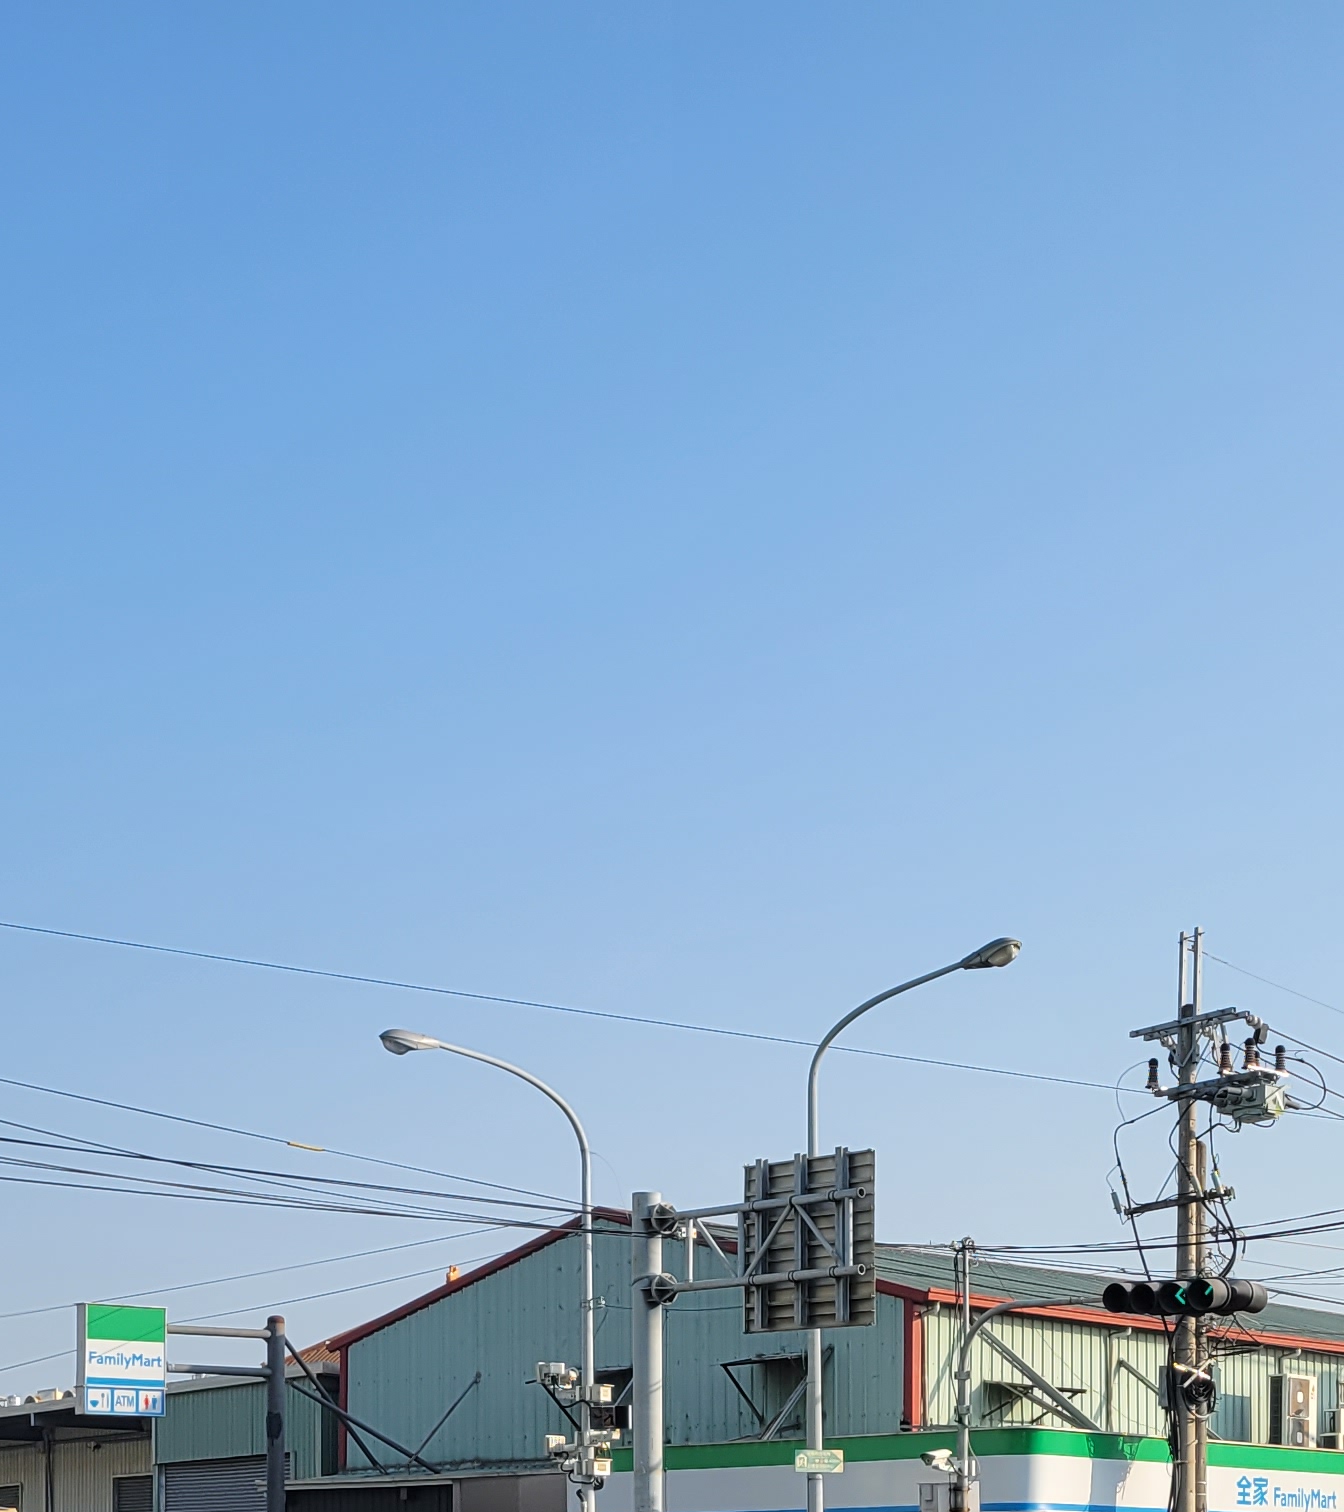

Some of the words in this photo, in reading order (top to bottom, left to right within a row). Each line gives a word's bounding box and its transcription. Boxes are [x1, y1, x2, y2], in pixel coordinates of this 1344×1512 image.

[88, 1351, 163, 1371] FamilyMart
[115, 1394, 135, 1408] ATM
[1236, 1475, 1269, 1506] 全家
[1273, 1486, 1338, 1512] FamilyMart
